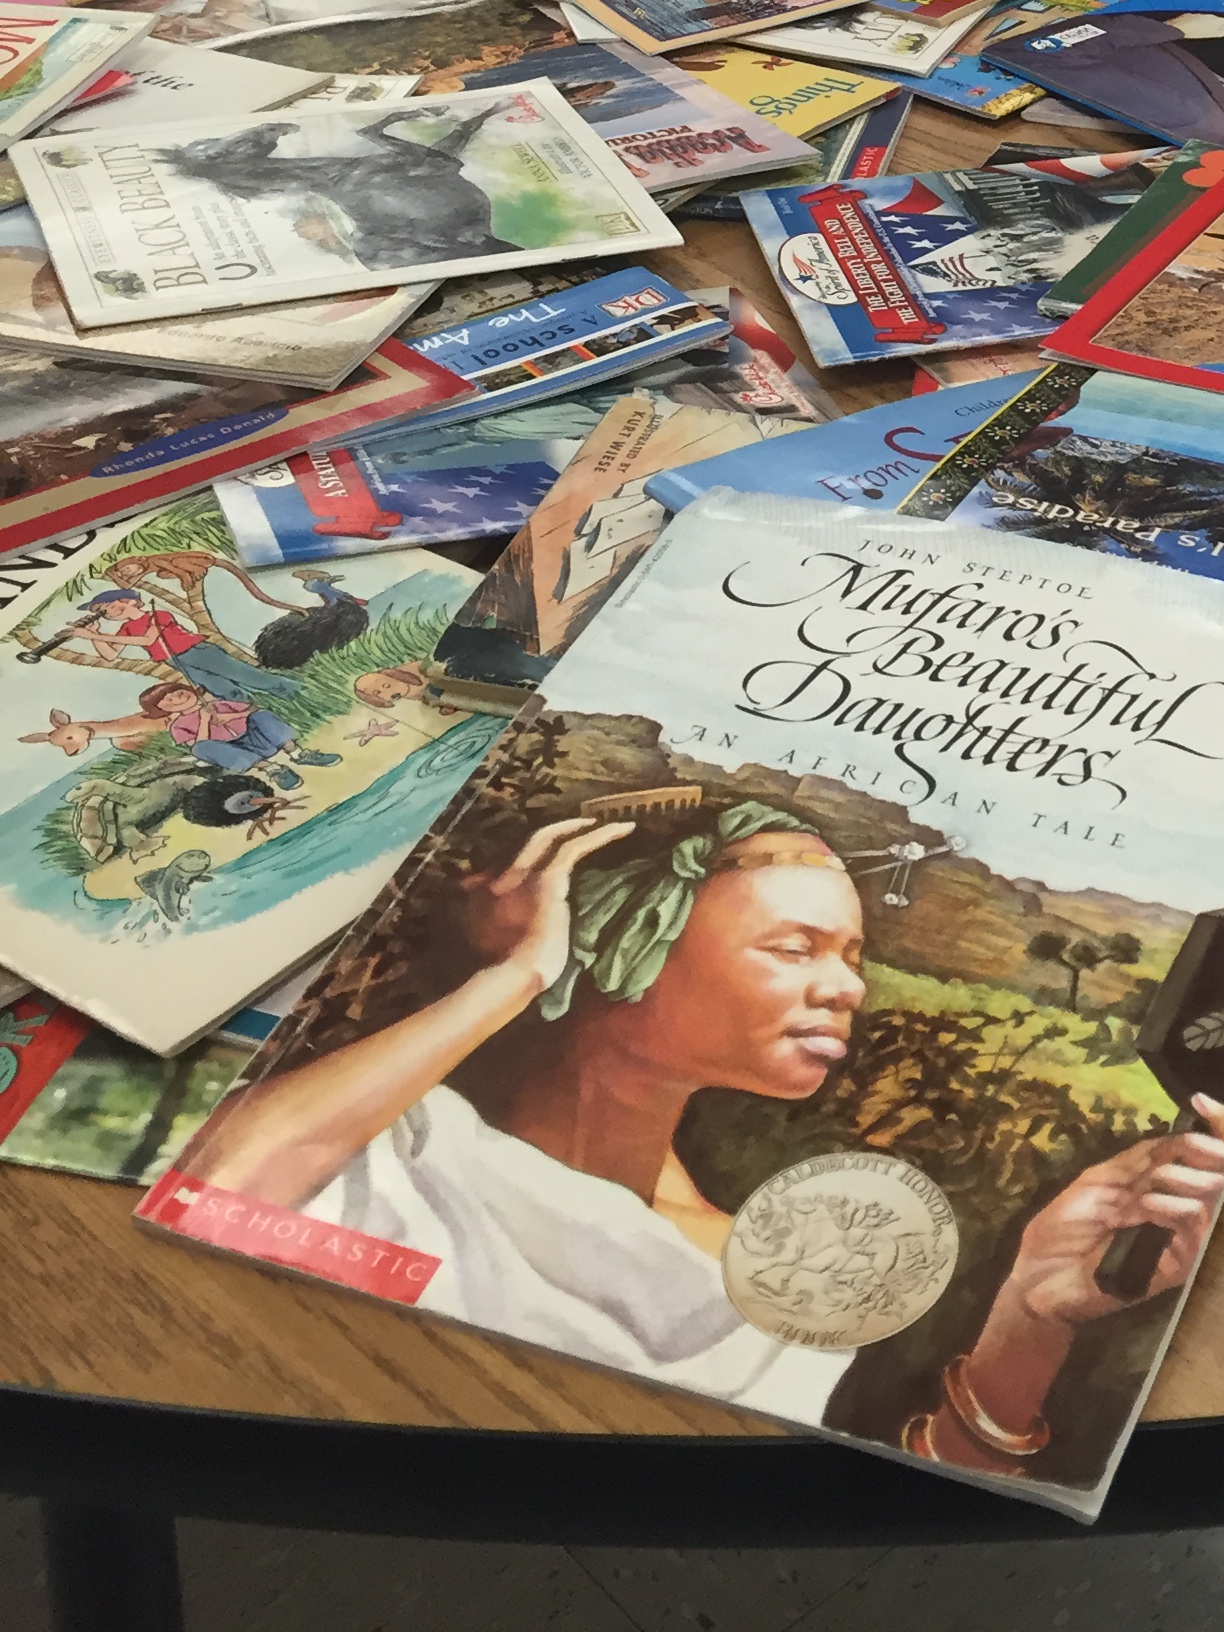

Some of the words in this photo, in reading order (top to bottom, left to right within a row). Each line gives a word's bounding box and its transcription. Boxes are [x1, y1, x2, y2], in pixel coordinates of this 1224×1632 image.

[748, 77, 865, 119] Things
[93, 142, 172, 215] BEAUTY
[855, 146, 879, 179] LASTIC
[824, 218, 847, 235] AND
[834, 237, 858, 259] BELL
[836, 202, 884, 264] INDEPENDENCE
[131, 212, 209, 293] BLACK
[871, 262, 895, 280] FOR
[846, 258, 881, 295] LIBERTY
[881, 278, 907, 309] FIGHT
[488, 301, 567, 328] The
[605, 288, 666, 316] DK
[866, 293, 889, 314] THE
[897, 305, 920, 326] THE
[471, 322, 576, 367] school
[102, 449, 165, 475] Rhonda
[169, 431, 215, 452] Lucas
[219, 411, 276, 435] Donald
[618, 410, 647, 440] KURT
[624, 413, 664, 461] ILLUSTRATED
[594, 440, 626, 474] WIESE
[615, 462, 632, 474] BY
[816, 458, 921, 502] From
[991, 490, 1165, 544] Paradise
[855, 538, 943, 568] JOHN
[962, 560, 1097, 600] STEPTOE
[721, 551, 1084, 652] Mufaro's
[733, 658, 1129, 810] Daughters
[668, 723, 739, 752] AN
[777, 745, 998, 819] AFRICAN
[1030, 810, 1129, 851] TALE
[766, 1155, 894, 1196] CALDECOTT
[899, 1160, 954, 1228] HONOR
[203, 1197, 428, 1283] SCHOLASTIC
